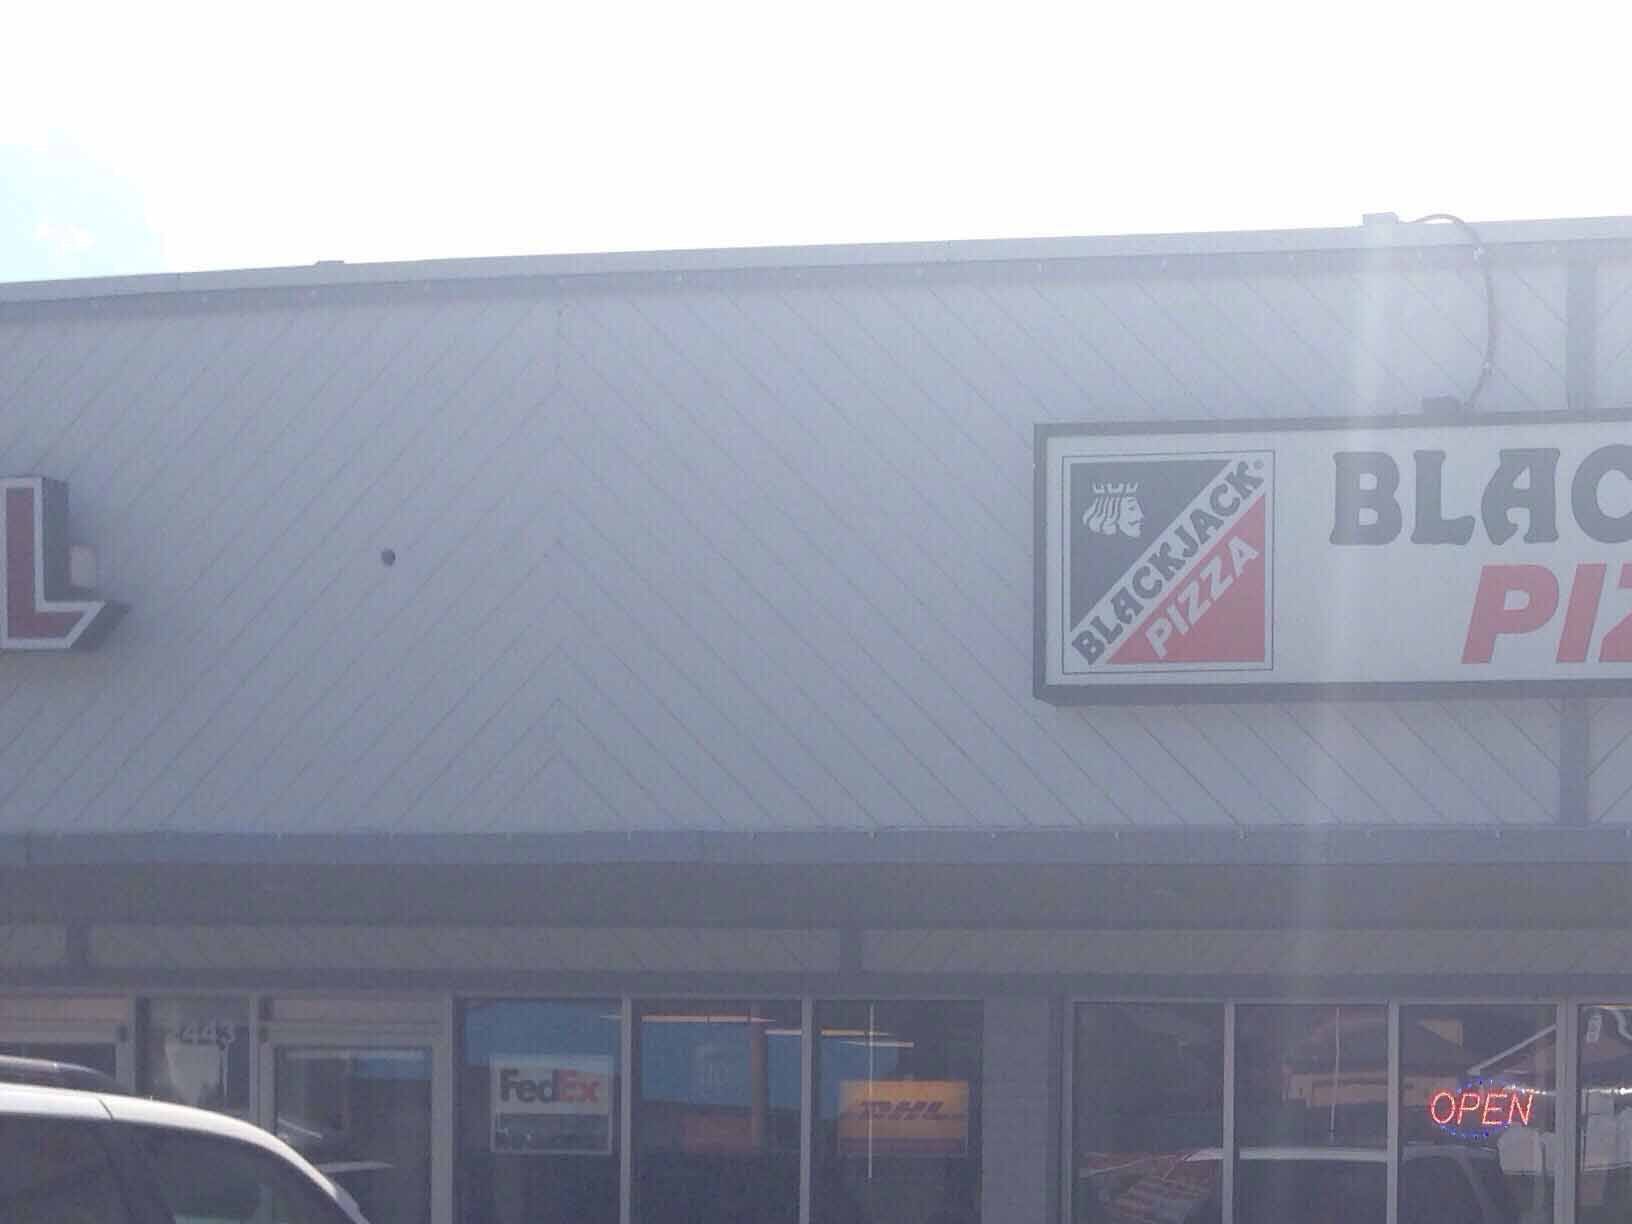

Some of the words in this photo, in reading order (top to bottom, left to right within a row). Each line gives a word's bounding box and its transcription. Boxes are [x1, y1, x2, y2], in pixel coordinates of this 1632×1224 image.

[1072, 461, 1265, 665] BLACKJACK
[1145, 536, 1260, 660] PIZZA
[166, 1021, 236, 1045] 443
[500, 1068, 600, 1103] FedEx
[860, 1099, 947, 1120] DHL
[1431, 1091, 1533, 1126] OPEN
